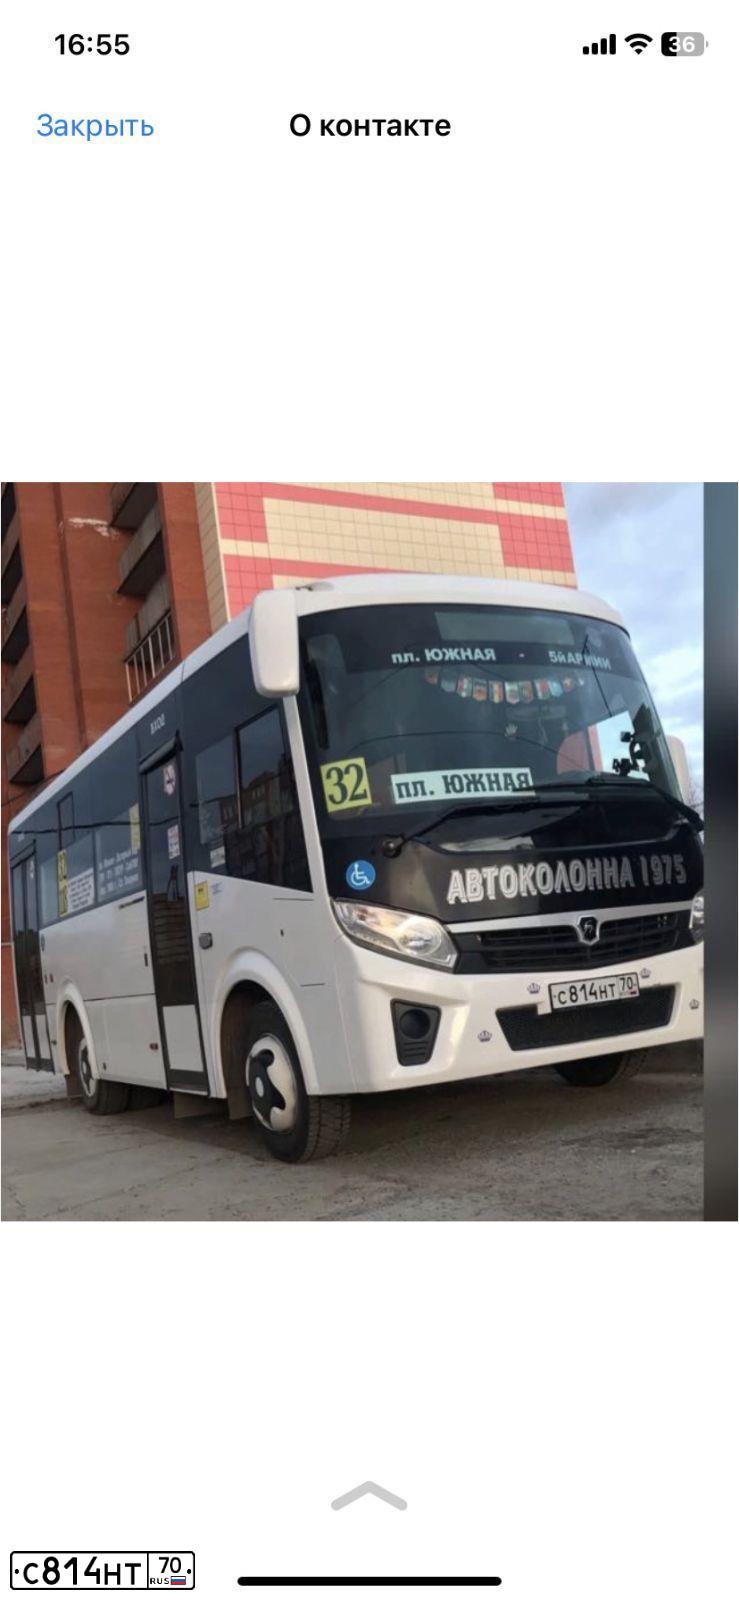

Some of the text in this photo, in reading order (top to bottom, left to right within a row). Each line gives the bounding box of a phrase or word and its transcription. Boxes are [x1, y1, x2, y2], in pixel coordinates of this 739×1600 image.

[391, 652, 420, 664] пл.
[424, 648, 497, 662] ЮЖНАЯ
[326, 763, 367, 805] 32
[395, 772, 533, 799] пл. ЮЖНАЯ
[446, 854, 687, 904] АВТОКОЛОННА 1975
[620, 977, 633, 991] 70
